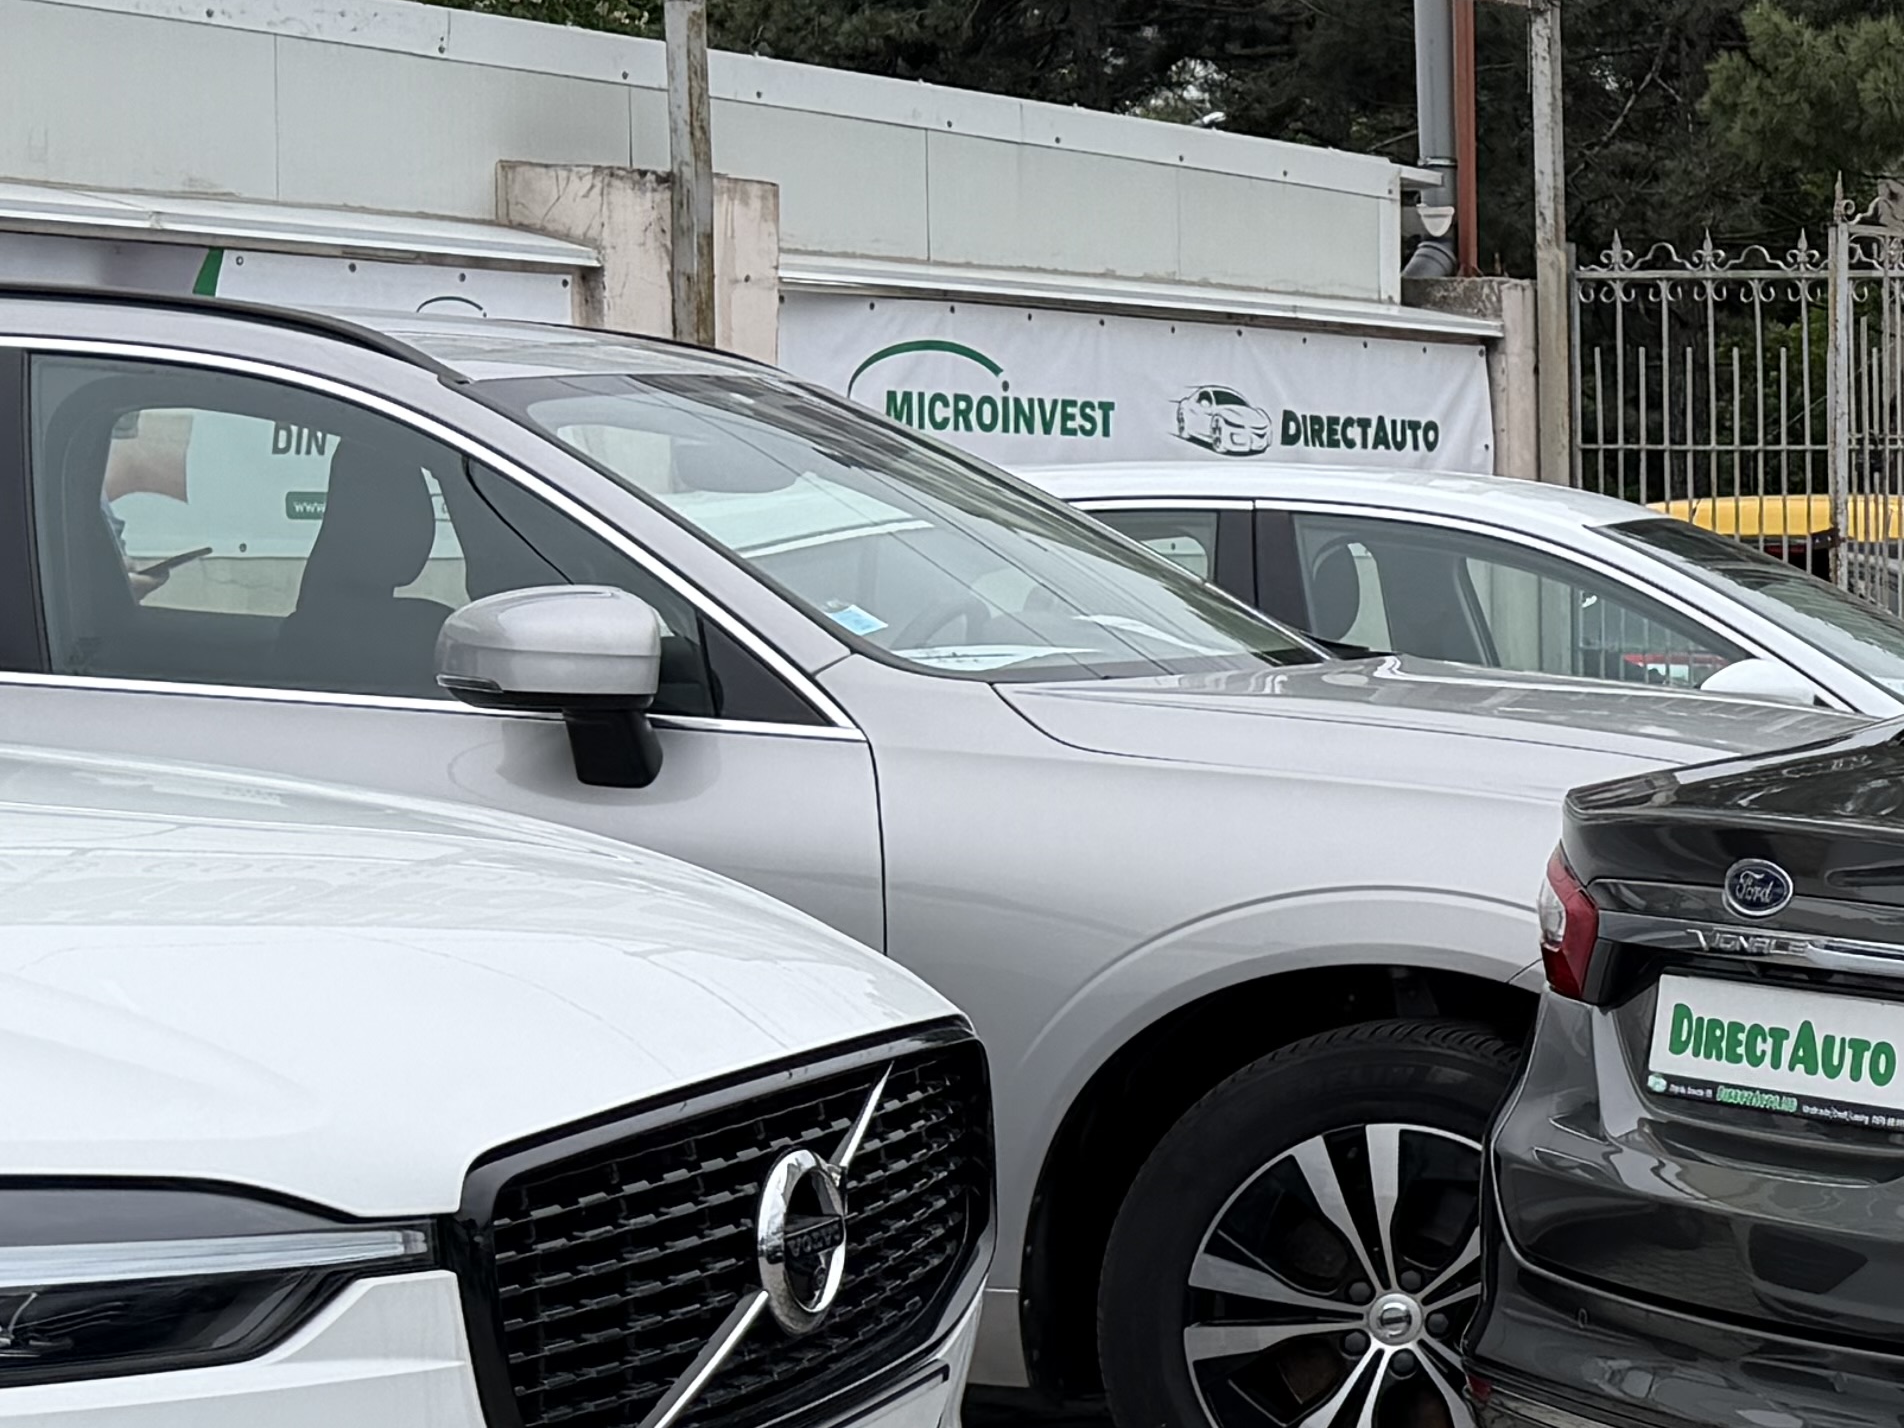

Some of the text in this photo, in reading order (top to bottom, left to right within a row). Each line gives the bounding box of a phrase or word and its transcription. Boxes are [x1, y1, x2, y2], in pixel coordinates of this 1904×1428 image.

[885, 388, 1115, 439] MICROINVEST
[1280, 408, 1440, 453] DIRECTAUTO
[1735, 869, 1775, 904] Ford
[1685, 928, 1809, 957] VIGNALE
[1667, 1001, 1897, 1088] DIRECTAUTO
